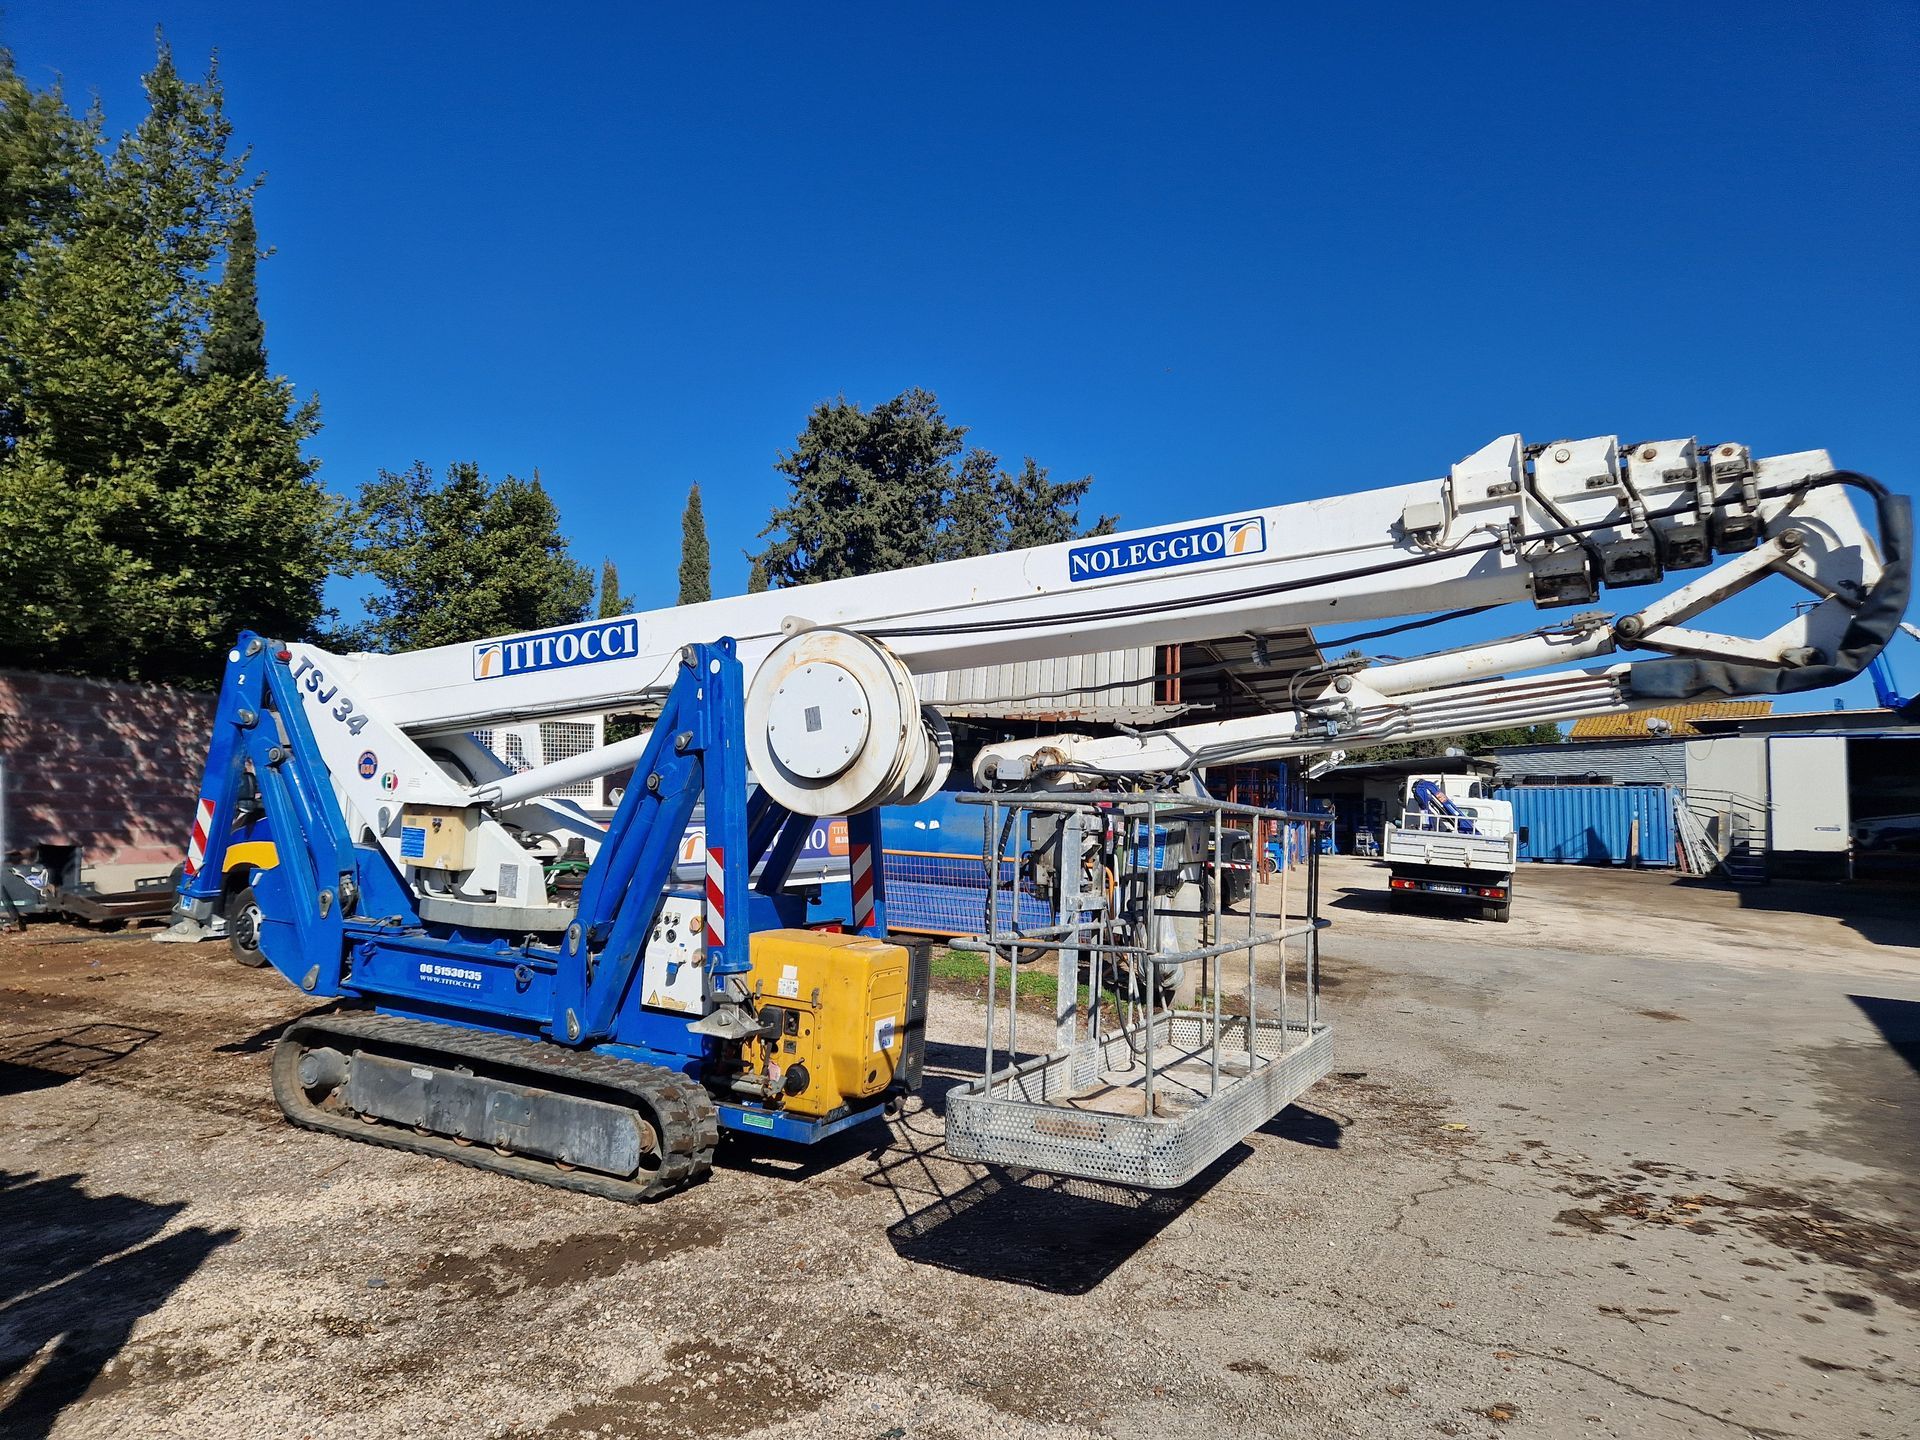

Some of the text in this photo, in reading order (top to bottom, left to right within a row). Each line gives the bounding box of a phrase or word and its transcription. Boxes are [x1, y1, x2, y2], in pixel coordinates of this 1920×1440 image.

[1072, 531, 1223, 575] NOLEGGIO
[505, 624, 635, 671] TITOCCI
[238, 674, 246, 685] 2
[697, 688, 703, 700] 4
[293, 655, 369, 736] TSJ 34
[419, 963, 482, 981] 06 51530135
